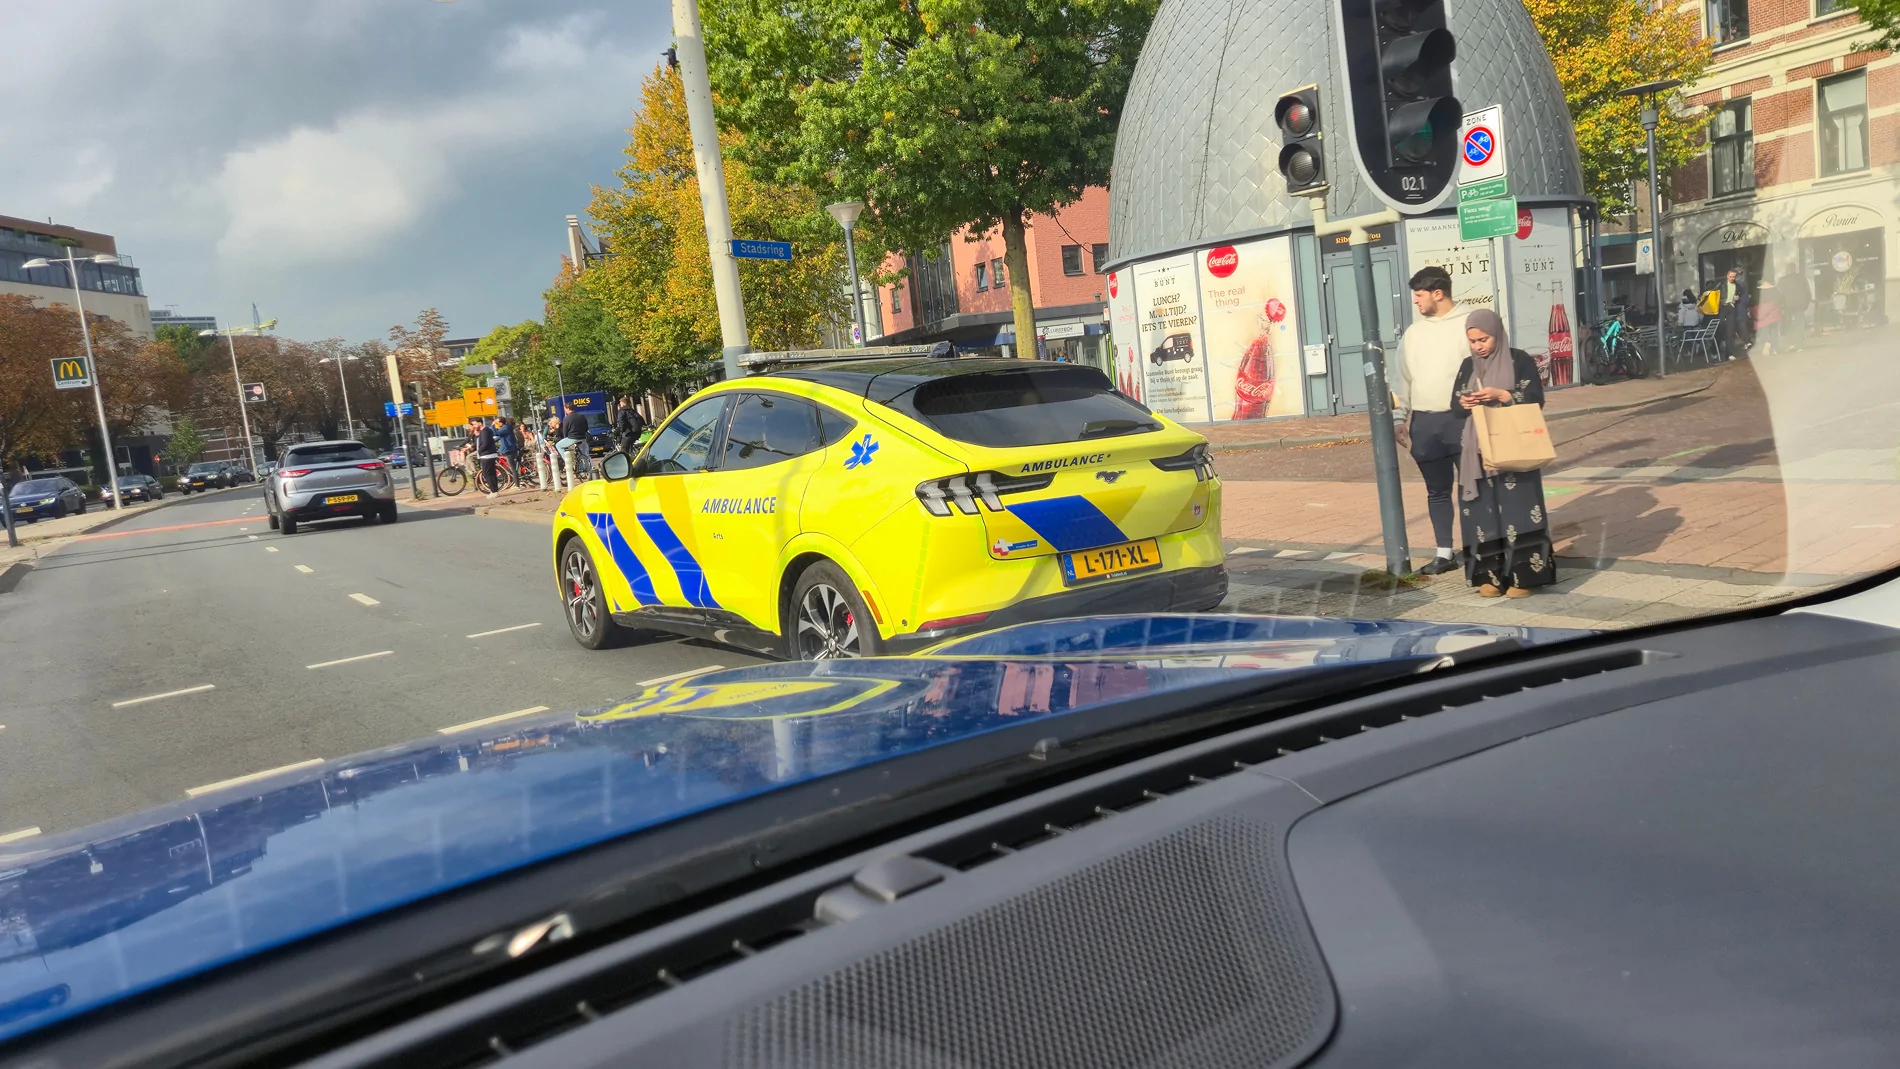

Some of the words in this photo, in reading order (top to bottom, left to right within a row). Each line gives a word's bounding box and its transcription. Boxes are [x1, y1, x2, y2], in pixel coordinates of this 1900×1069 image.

[1466, 114, 1487, 126] ZONE
[740, 242, 785, 258] Stadsring
[1209, 253, 1237, 268] Coca-Cola
[1424, 252, 1490, 265] MANNEKE
[1442, 259, 1490, 276] UNT
[1524, 261, 1555, 273] BUNT
[1208, 289, 1226, 298] The
[1228, 285, 1245, 296] real
[1153, 293, 1181, 306] LUNCH?
[1215, 297, 1240, 307] thing
[1158, 321, 1168, 330] TE
[1168, 316, 1198, 328] VIEREN?
[573, 397, 591, 405] DIKS
[1021, 453, 1105, 473] AMBULANCE
[701, 497, 776, 514] AMBULANCE
[1084, 545, 1149, 573] L-171-XL
